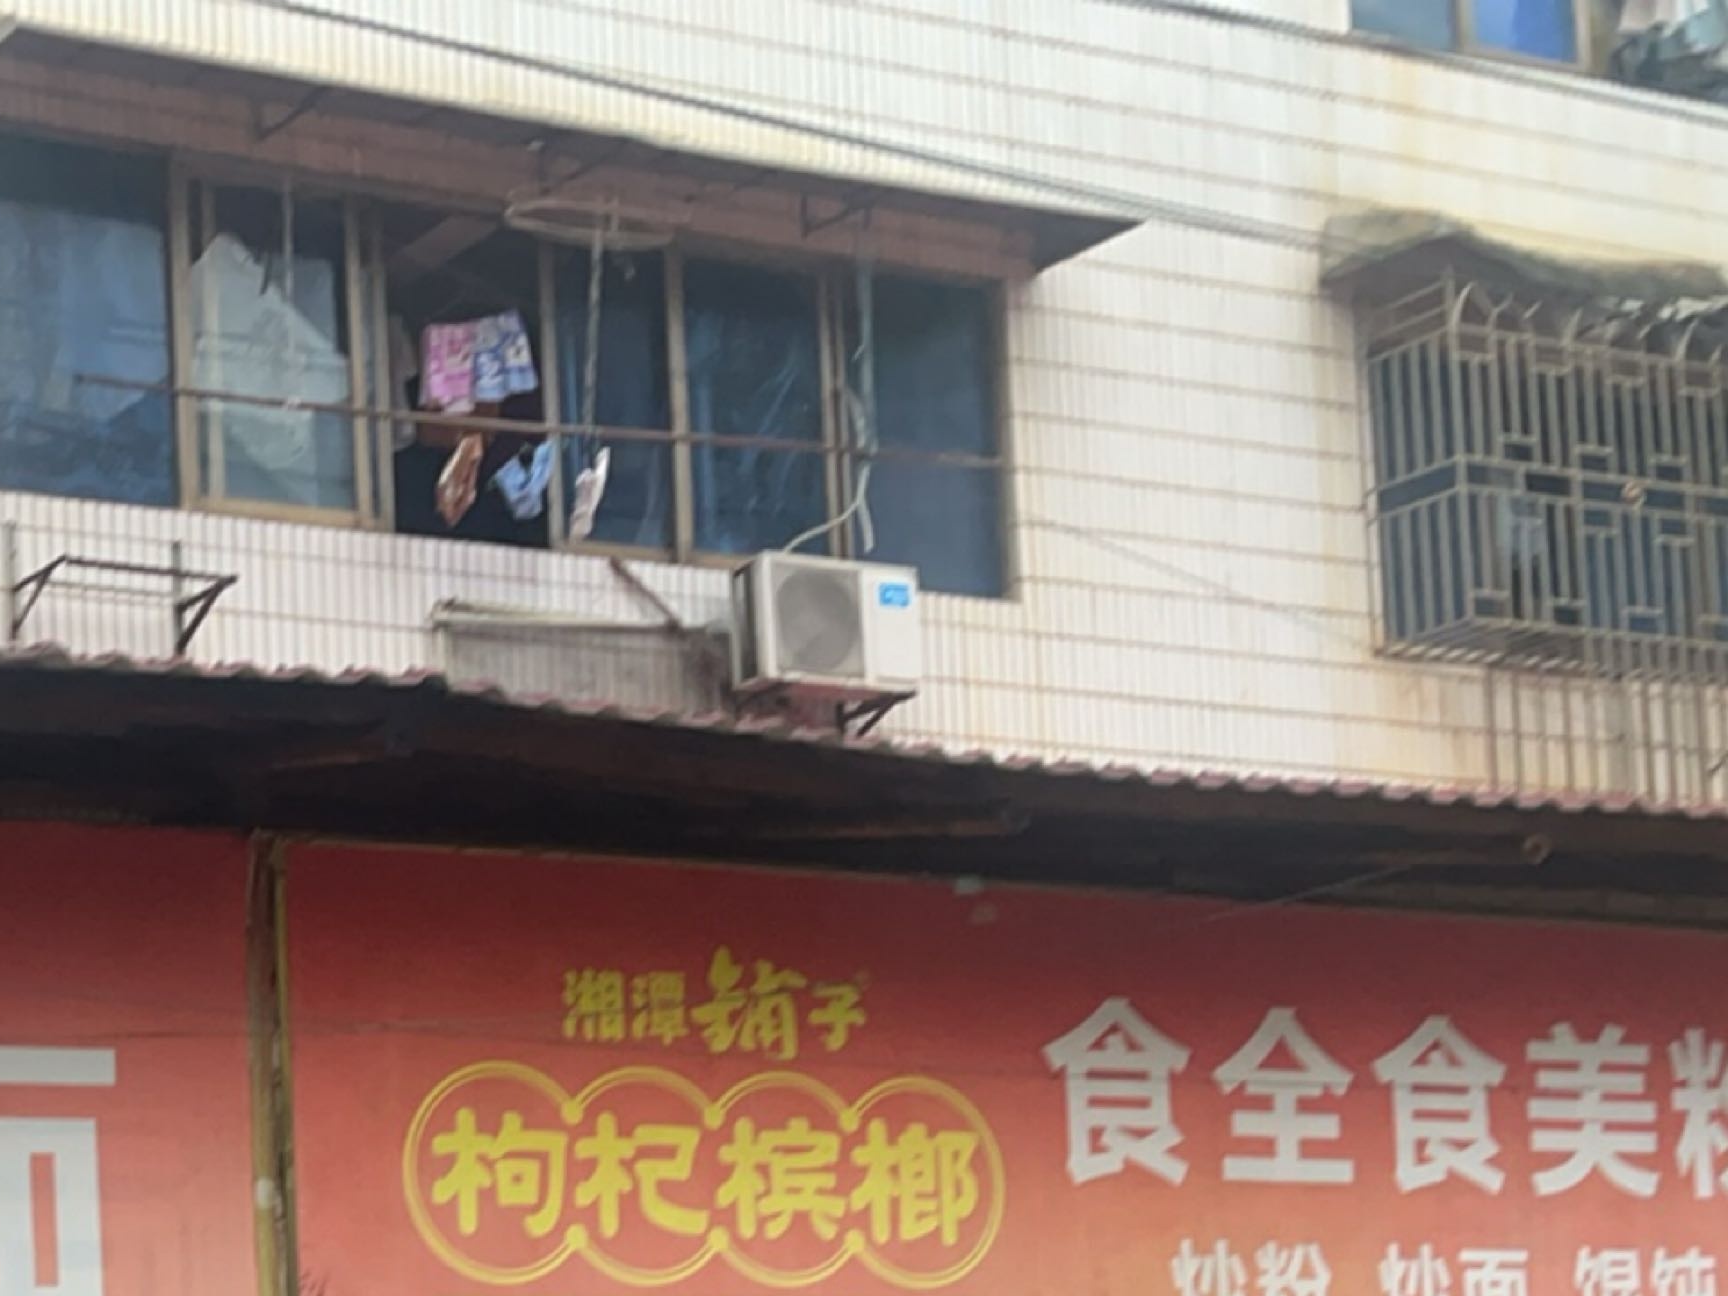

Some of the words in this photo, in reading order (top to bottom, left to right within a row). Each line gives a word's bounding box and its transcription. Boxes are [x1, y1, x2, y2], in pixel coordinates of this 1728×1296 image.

[562, 945, 866, 1060] 湘潭铺子
[430, 1107, 979, 1247] 枸杞槟榔
